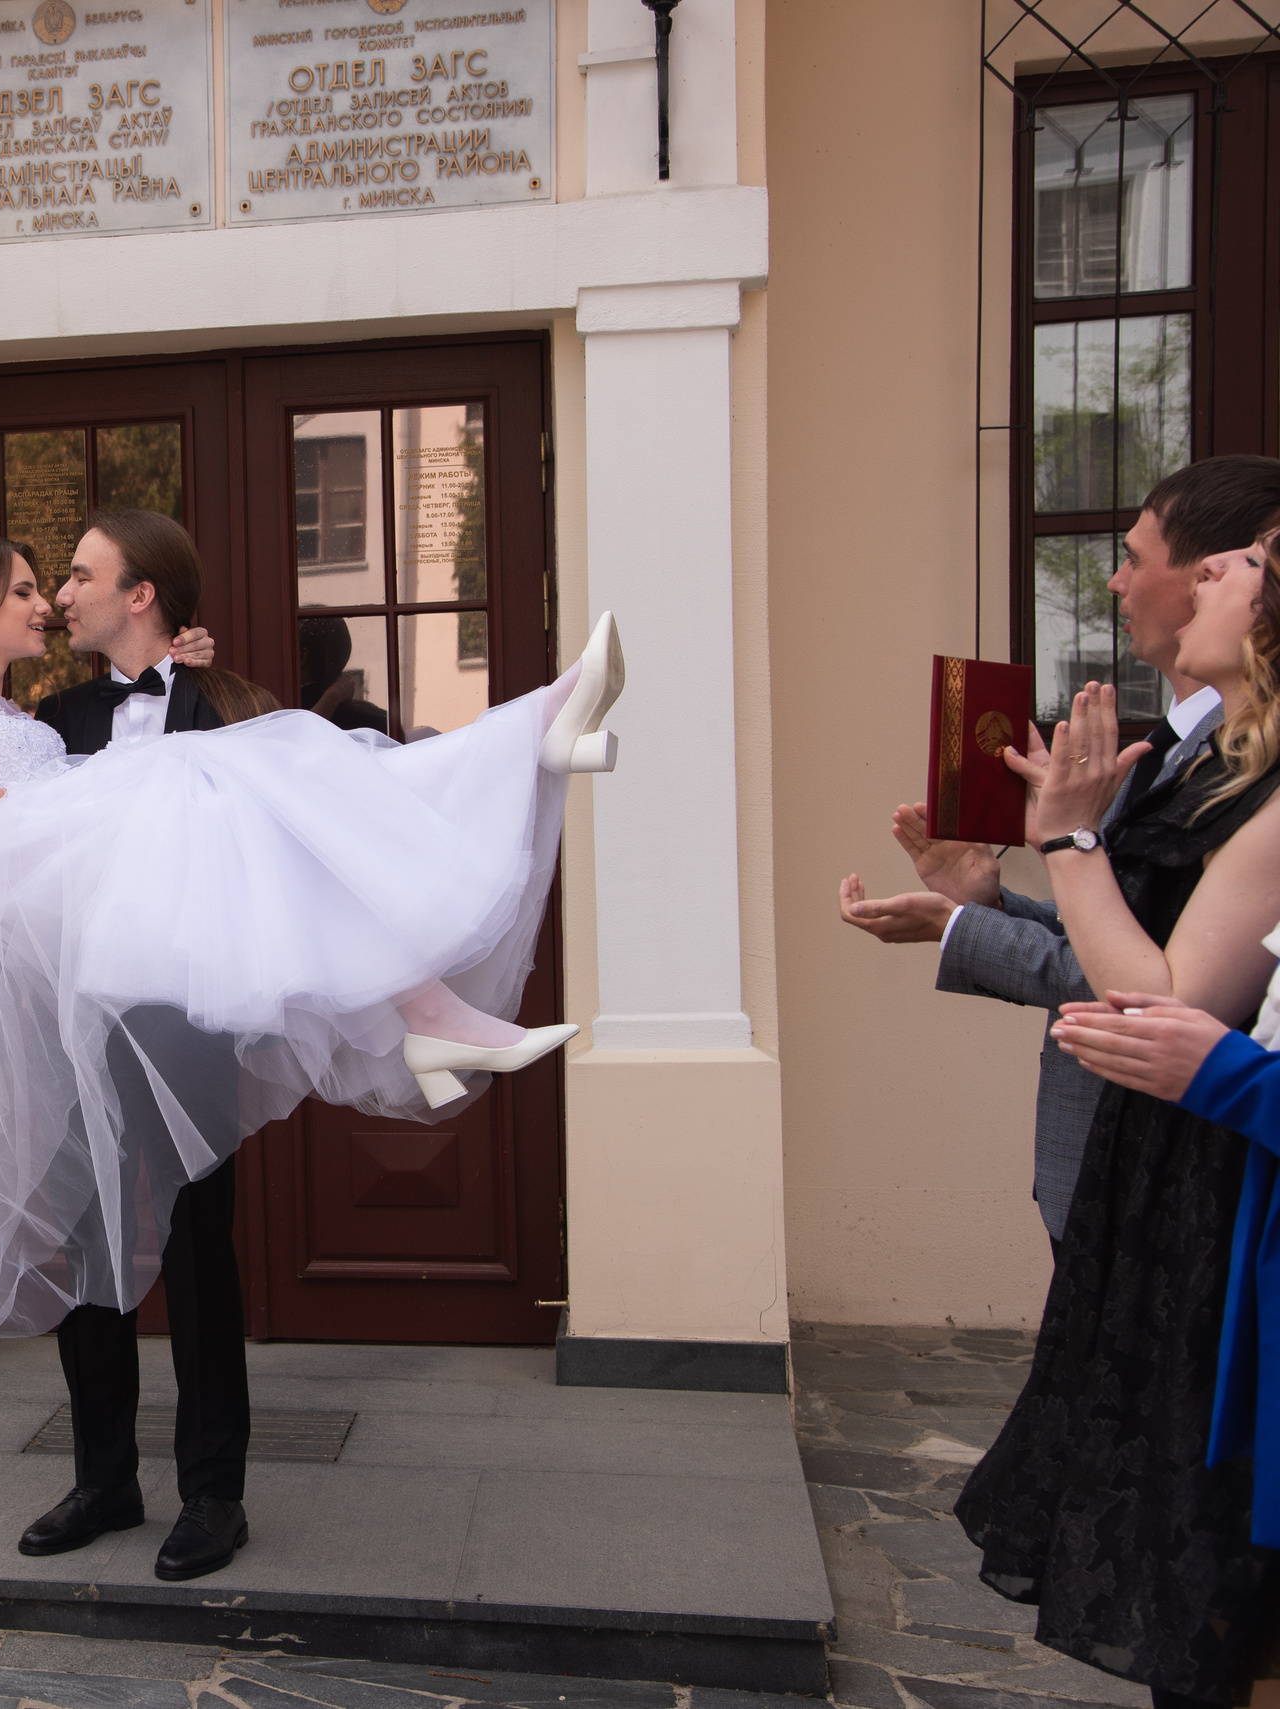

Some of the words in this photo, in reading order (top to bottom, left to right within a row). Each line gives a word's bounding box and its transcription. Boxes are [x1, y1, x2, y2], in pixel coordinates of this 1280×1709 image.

[85, 10, 144, 26] БЕЛАРУСЬ
[253, 29, 313, 47] МИНСКИЙ
[325, 20, 404, 40] ГОРОДСКОЙ
[415, 9, 527, 32] ИСПОЛНИТЕЛЬНЫЙ
[359, 35, 416, 52] КОМИТЕТ
[11, 51, 66, 67] ГАРАДСКІ
[289, 58, 385, 91] ОТДЕЛ
[411, 50, 488, 81] ЗАГС
[28, 65, 79, 81] КАМІТЭТ
[88, 80, 161, 109] ЗАГС
[350, 86, 431, 109] ЗАПИСЕЙ
[447, 80, 509, 101] АКТОВ
[32, 111, 102, 137] ЗАПІСАЎ
[118, 106, 172, 130] АКТАЎ
[251, 110, 402, 138] ГРАЖДАНСКОГО
[286, 127, 490, 166] АДМИНИСТРАЦИИ
[249, 159, 419, 192] ЦЕНТРАЛЬНОГО
[437, 150, 532, 178] РАЙОНА
[113, 176, 181, 202] РАЁНА
[359, 187, 435, 208] МИНСКА
[33, 211, 99, 232] МІНСКА
[408, 472, 436, 480] РЕЖИМ
